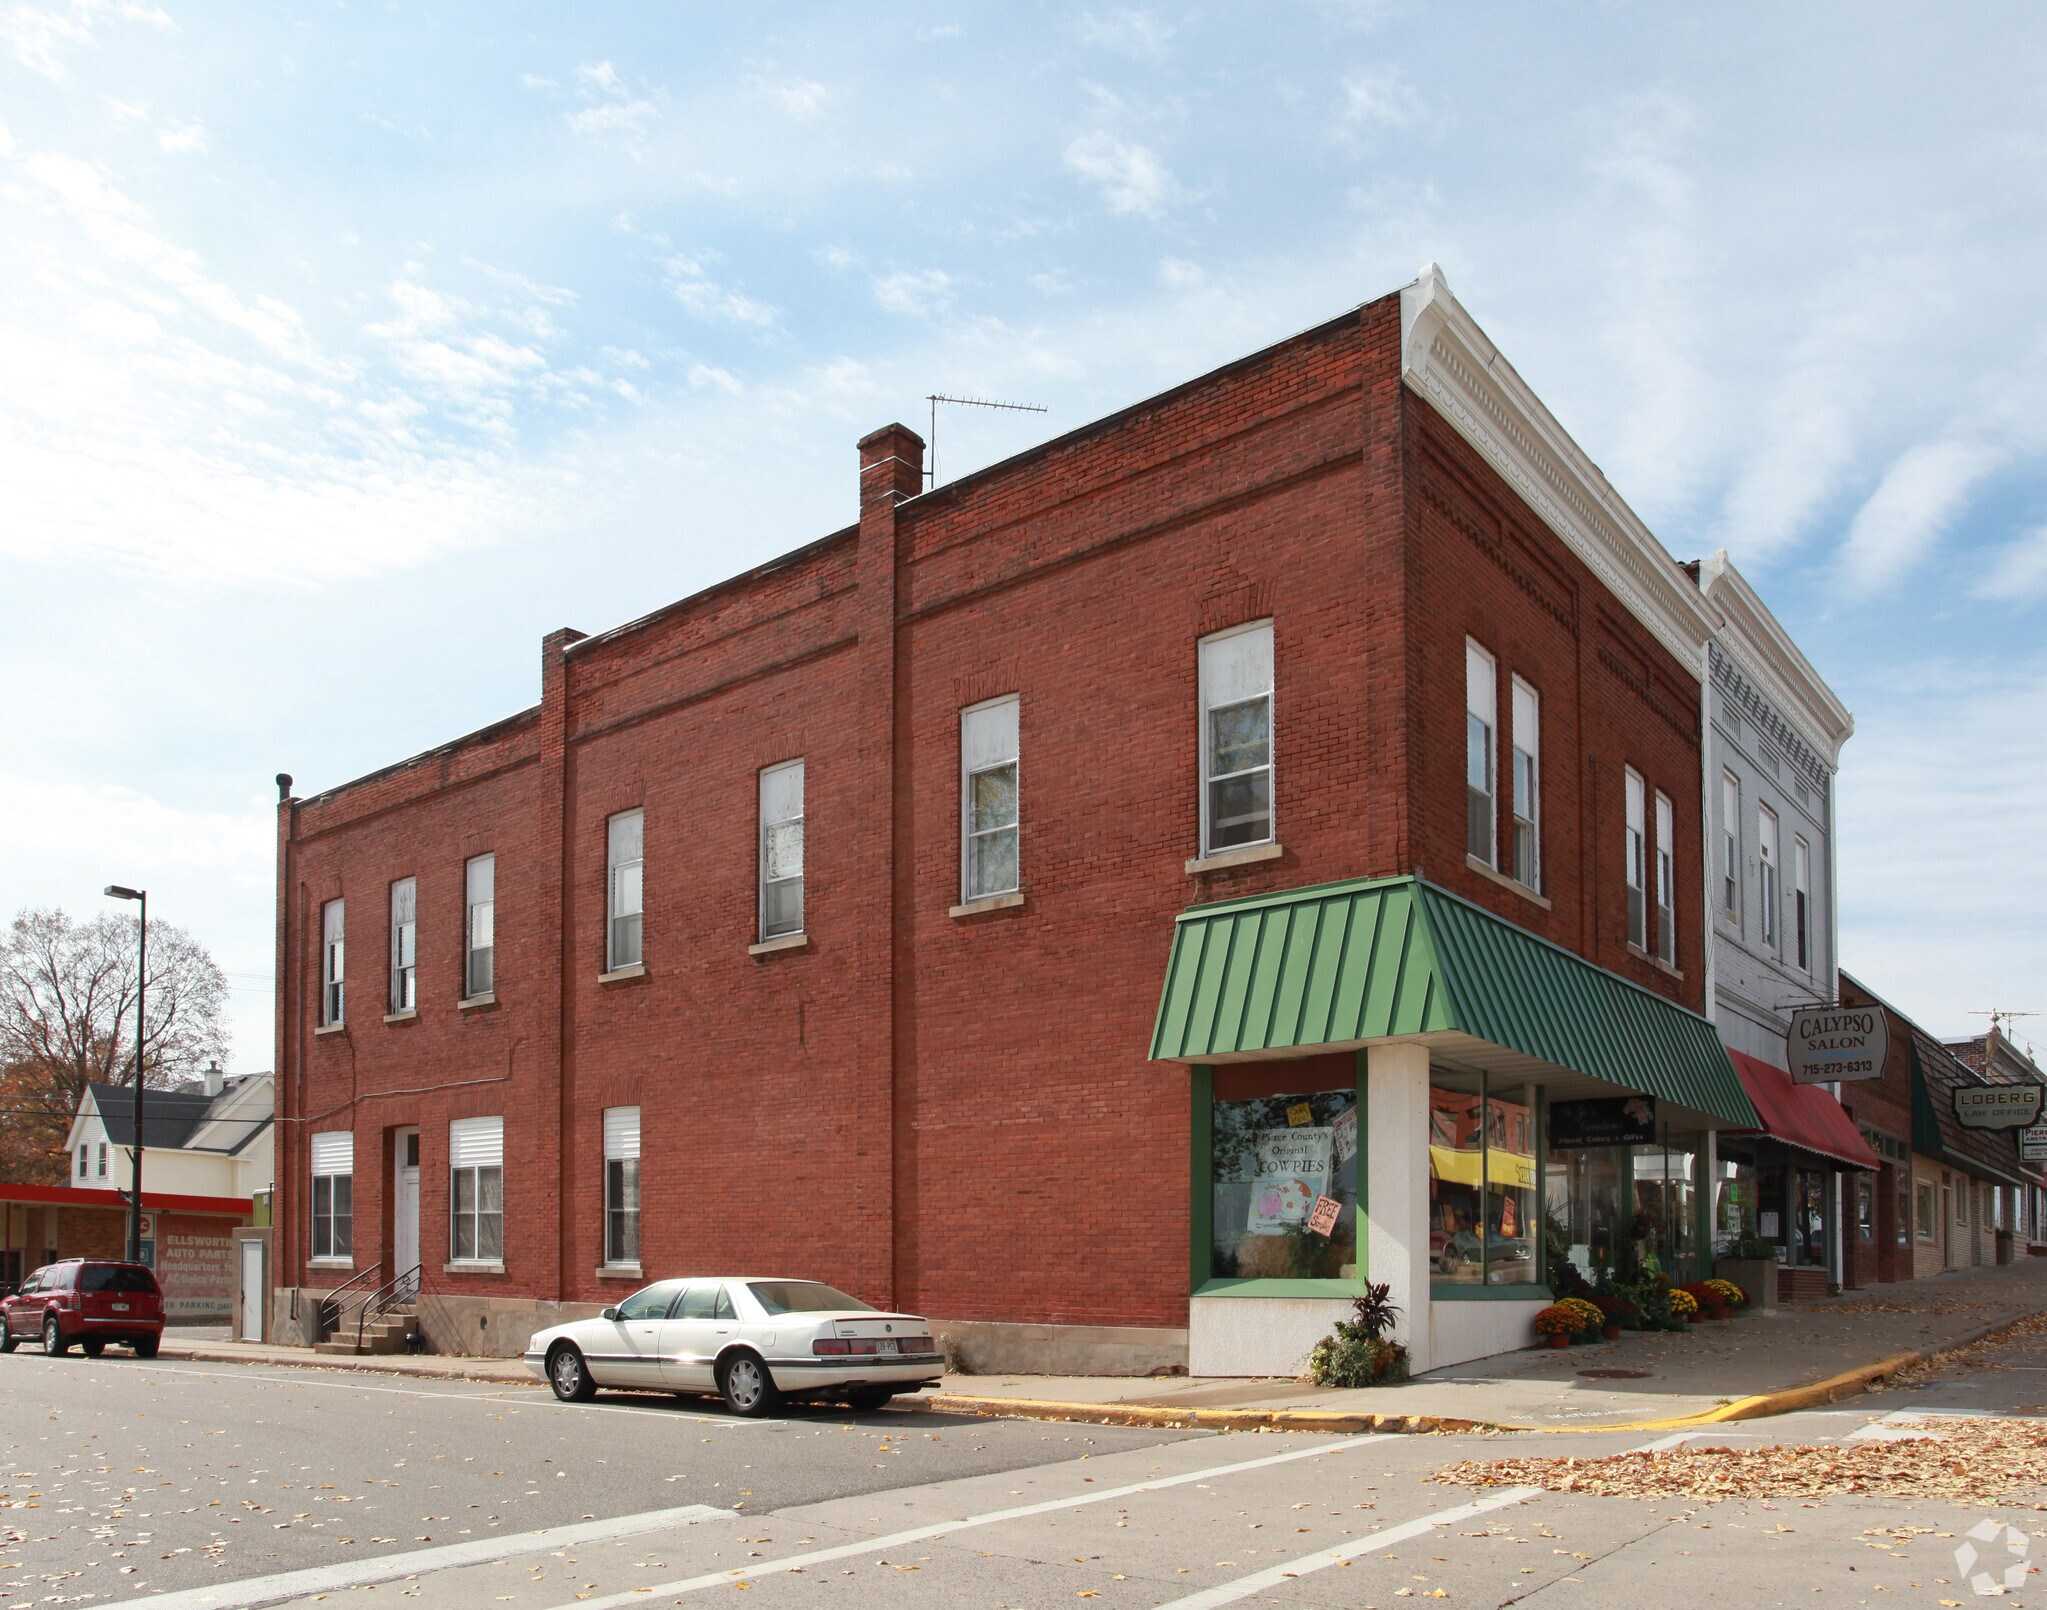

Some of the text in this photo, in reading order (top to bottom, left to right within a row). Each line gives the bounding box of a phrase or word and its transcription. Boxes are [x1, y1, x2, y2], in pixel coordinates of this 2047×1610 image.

[1800, 1013, 1873, 1039] CALYPSO
[1808, 1036, 1866, 1051] SALON
[1802, 1060, 1872, 1075] 715-273-6313
[1961, 1092, 2035, 1105] LOBERG
[1993, 1108, 2032, 1116] OFFICE
[1262, 1131, 1328, 1143] Pierce County's
[2025, 1128, 2047, 1136] PIERC
[1272, 1146, 1308, 1156] Original
[1259, 1160, 1324, 1173] COWPIES
[1315, 1199, 1339, 1219] FREE
[167, 1235, 232, 1247] ELLSWORTH
[167, 1249, 233, 1259] AUTO PARTS
[161, 1261, 233, 1272] Headquarters fo
